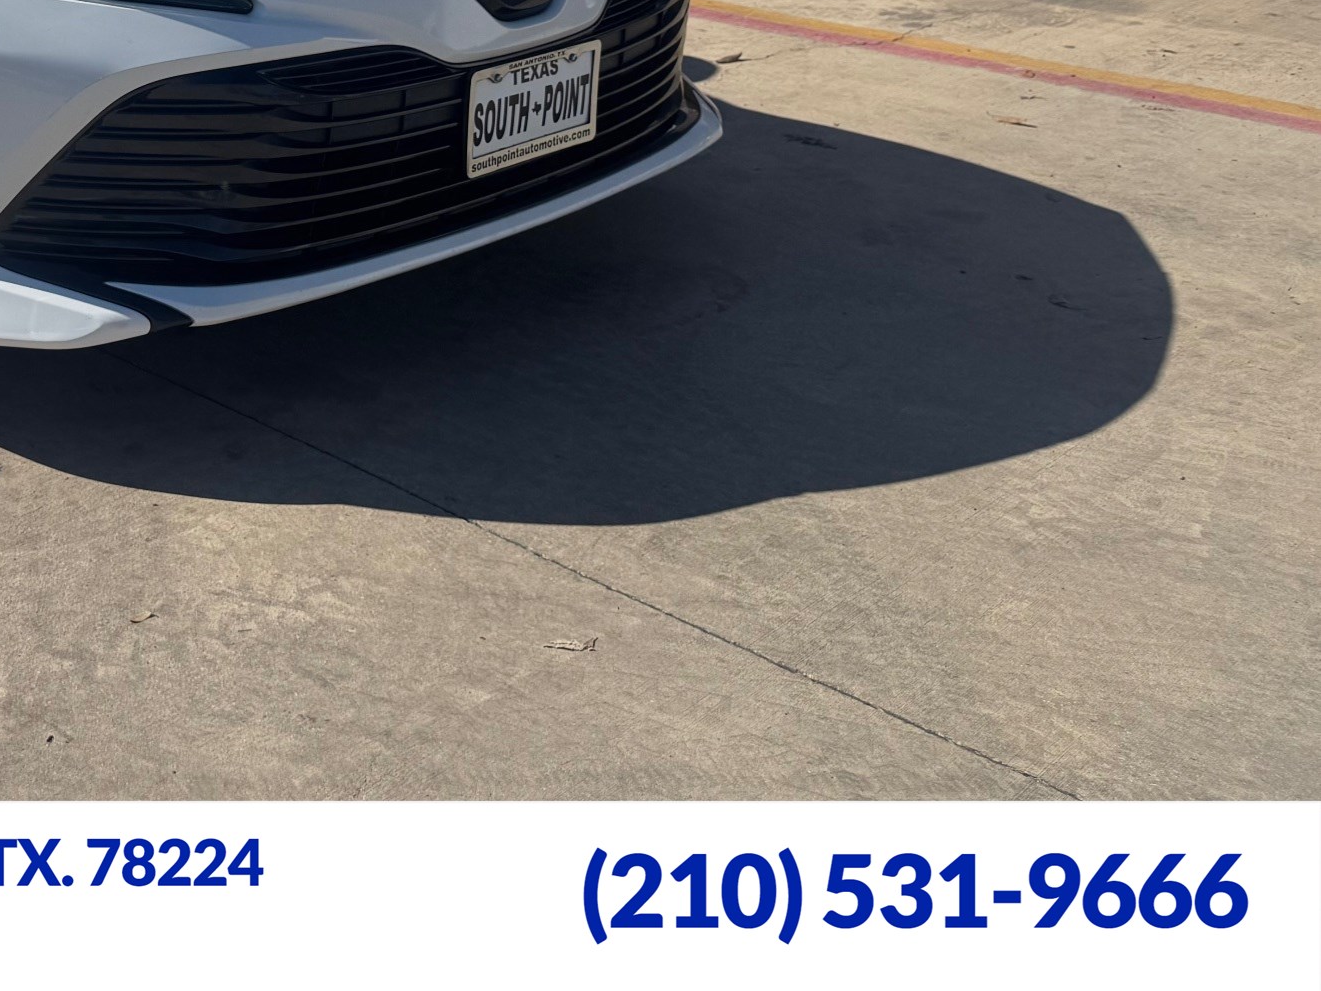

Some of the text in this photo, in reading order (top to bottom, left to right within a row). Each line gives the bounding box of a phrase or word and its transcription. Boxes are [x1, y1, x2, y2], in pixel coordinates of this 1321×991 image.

[509, 61, 523, 70] SAN
[511, 59, 559, 85] TEXAS
[473, 74, 590, 147] SOUTH POINT
[471, 128, 591, 173] southpointautomotive.com
